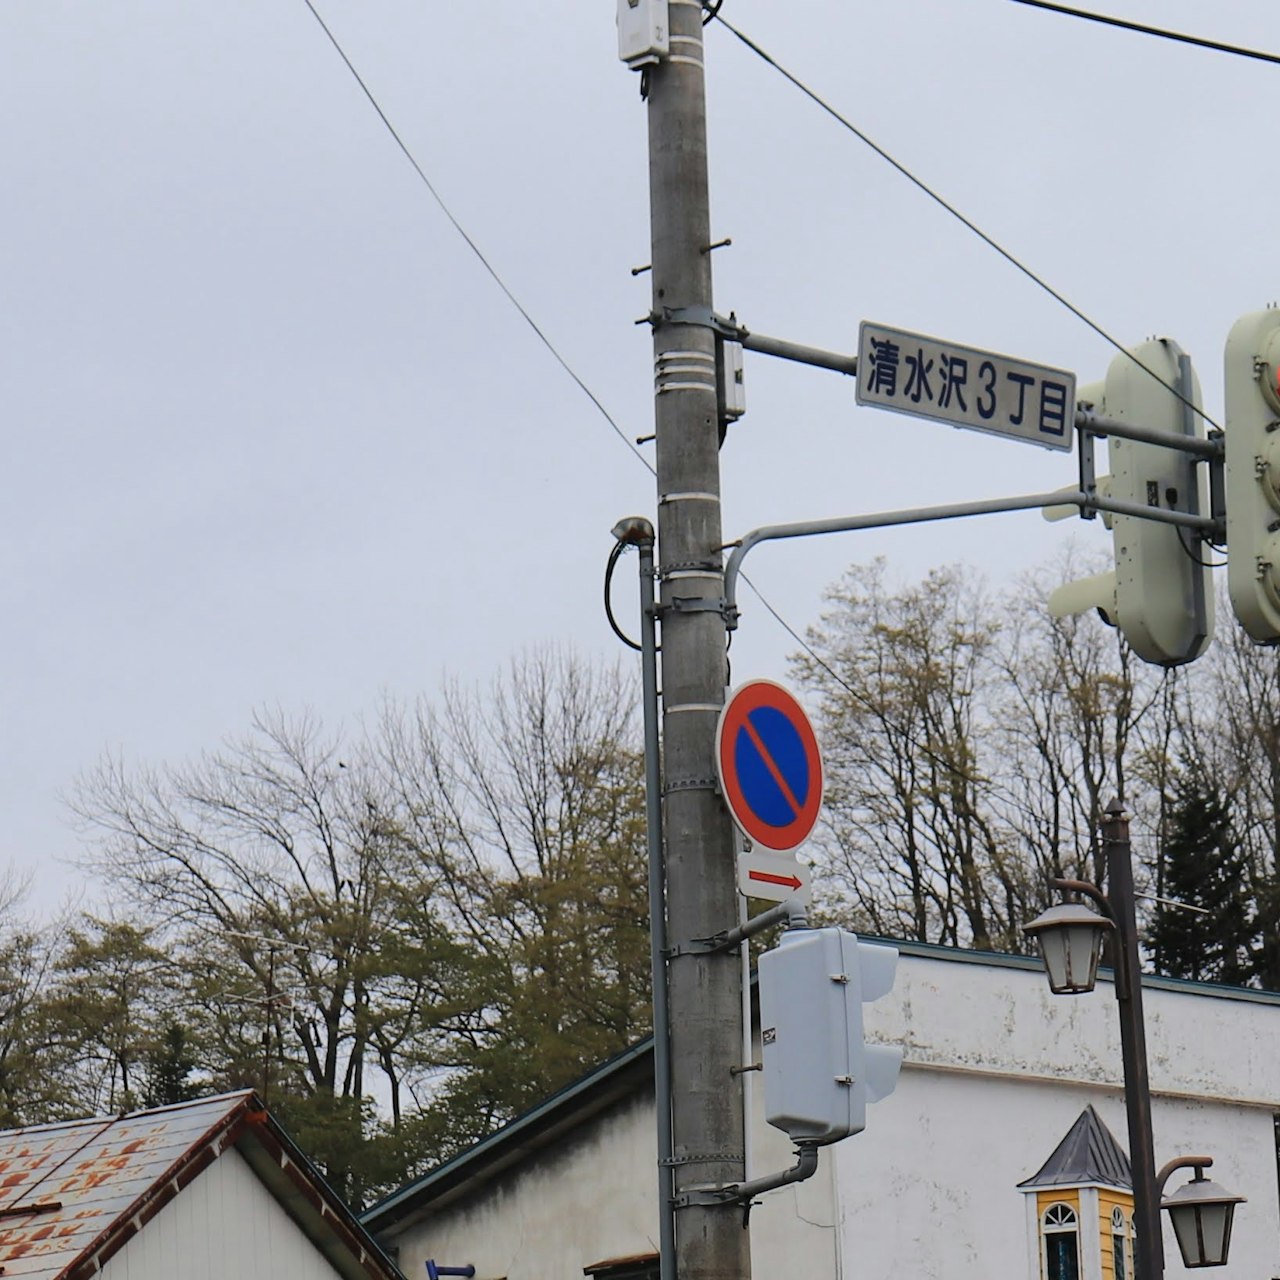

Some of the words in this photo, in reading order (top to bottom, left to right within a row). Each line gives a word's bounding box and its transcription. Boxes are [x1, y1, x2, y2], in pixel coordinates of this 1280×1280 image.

[867, 336, 1069, 436] 清水沢3丁目
